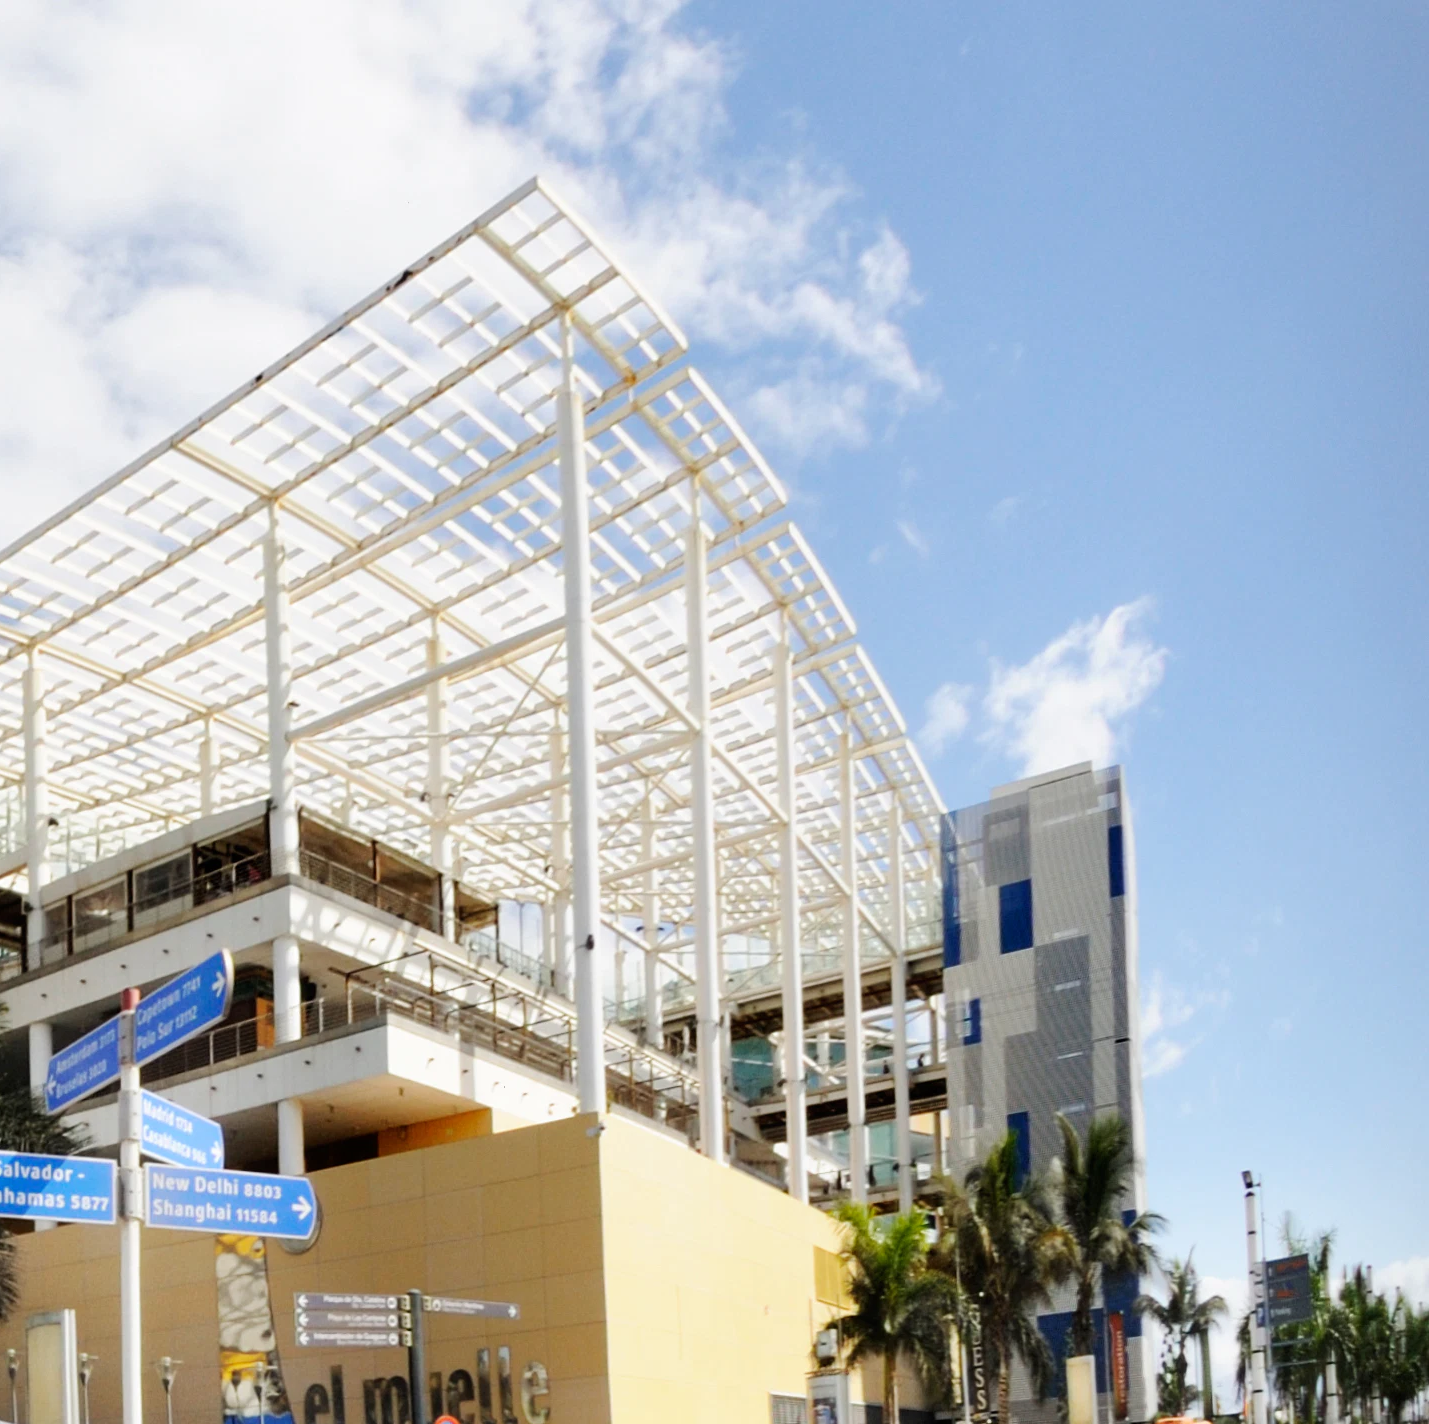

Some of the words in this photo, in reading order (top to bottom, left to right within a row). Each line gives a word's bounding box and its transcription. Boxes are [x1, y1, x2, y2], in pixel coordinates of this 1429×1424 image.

[137, 989, 181, 1026] Capetown
[137, 1030, 157, 1052] Polo
[157, 1020, 174, 1040] Sur
[56, 1041, 98, 1074] Amsterdam
[143, 1099, 174, 1126] Madrid
[143, 1124, 191, 1158] Casablanca
[153, 1174, 189, 1193] New
[194, 1175, 239, 1196] Delhi
[243, 1183, 282, 1200] 8803
[70, 1194, 109, 1212] 5877
[153, 1201, 231, 1224] Shanghai
[236, 1208, 278, 1225] 11584
